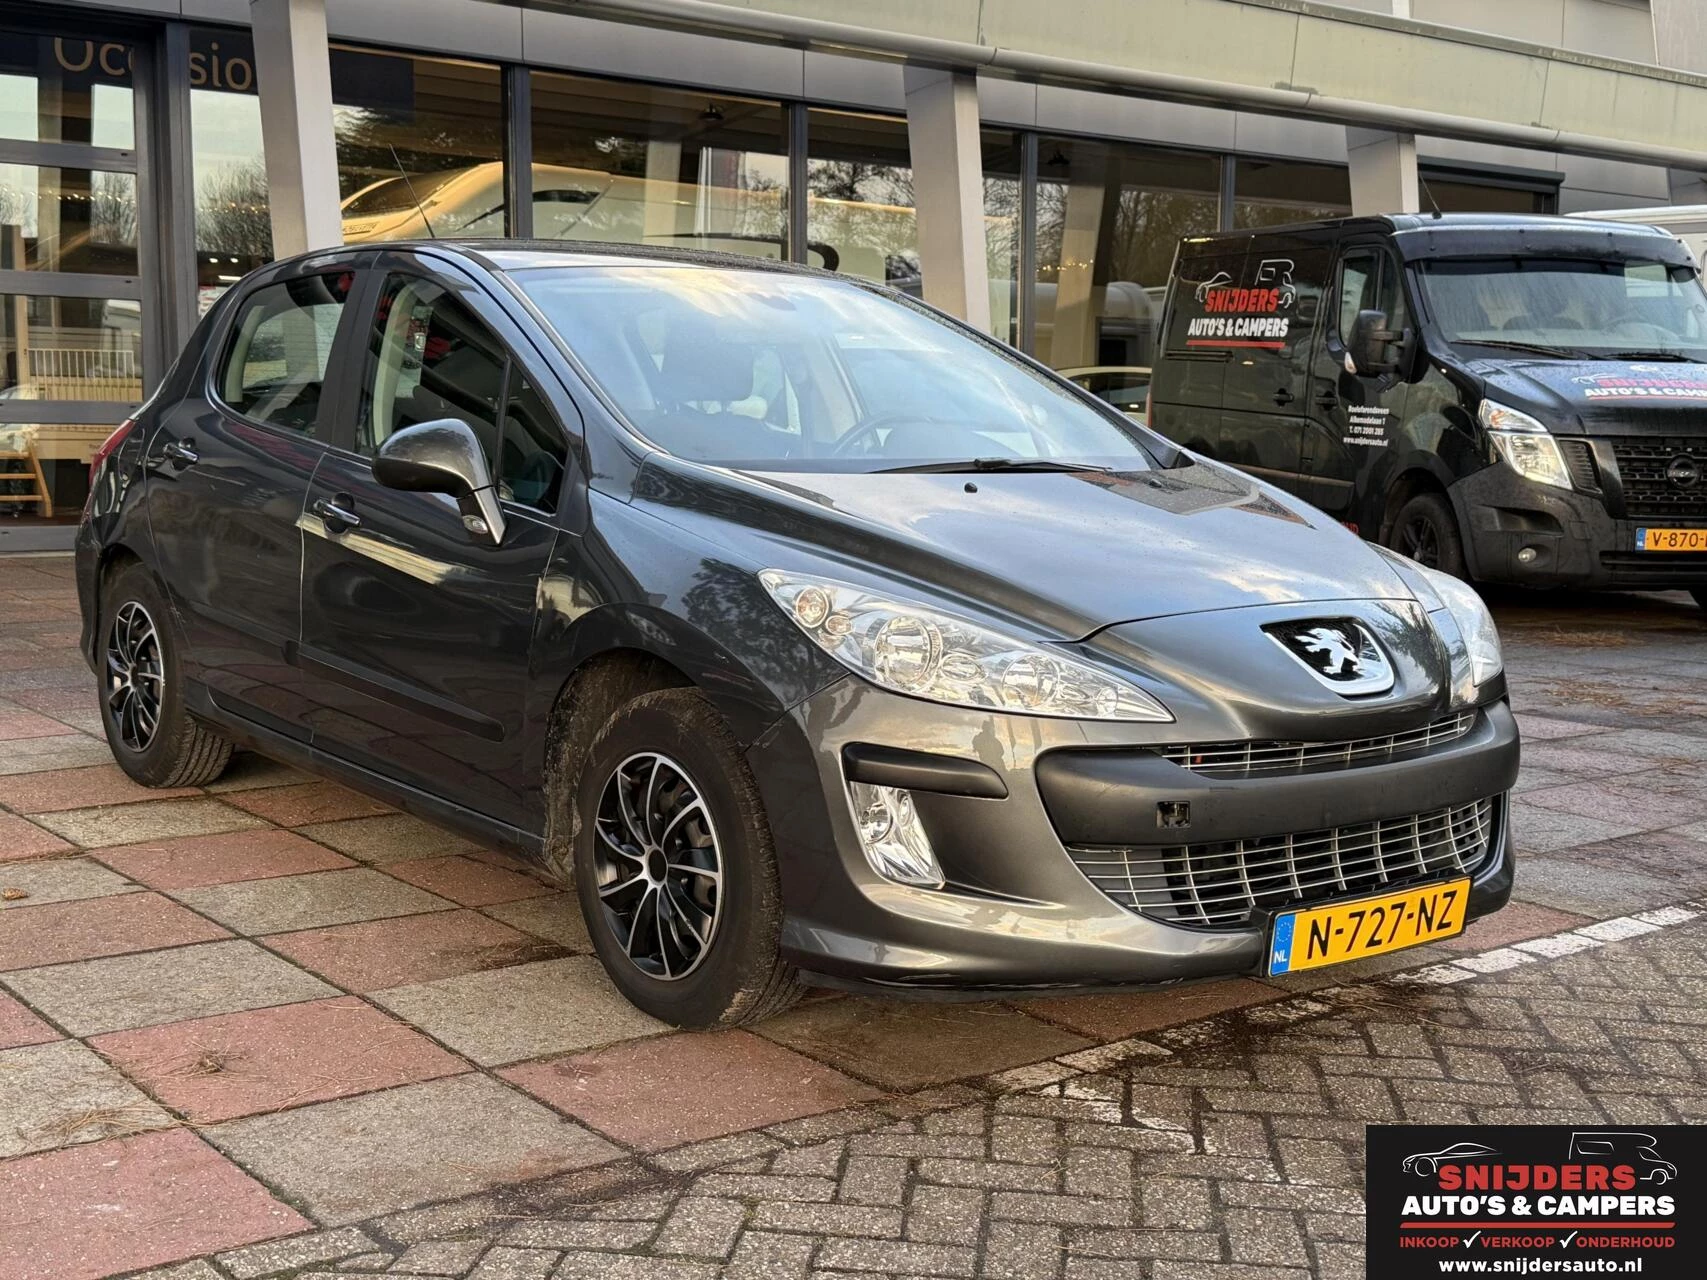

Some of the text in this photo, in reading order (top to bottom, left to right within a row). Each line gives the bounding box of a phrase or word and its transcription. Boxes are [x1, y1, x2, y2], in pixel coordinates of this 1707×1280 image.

[1204, 288, 1280, 312] SNIJDERS
[1187, 317, 1289, 337] AUTO'S & CAMPERS
[1584, 387, 1647, 396] AUTO'S
[1653, 532, 1707, 547] V-870-
[1274, 890, 1457, 964] NL N-727-NZ
